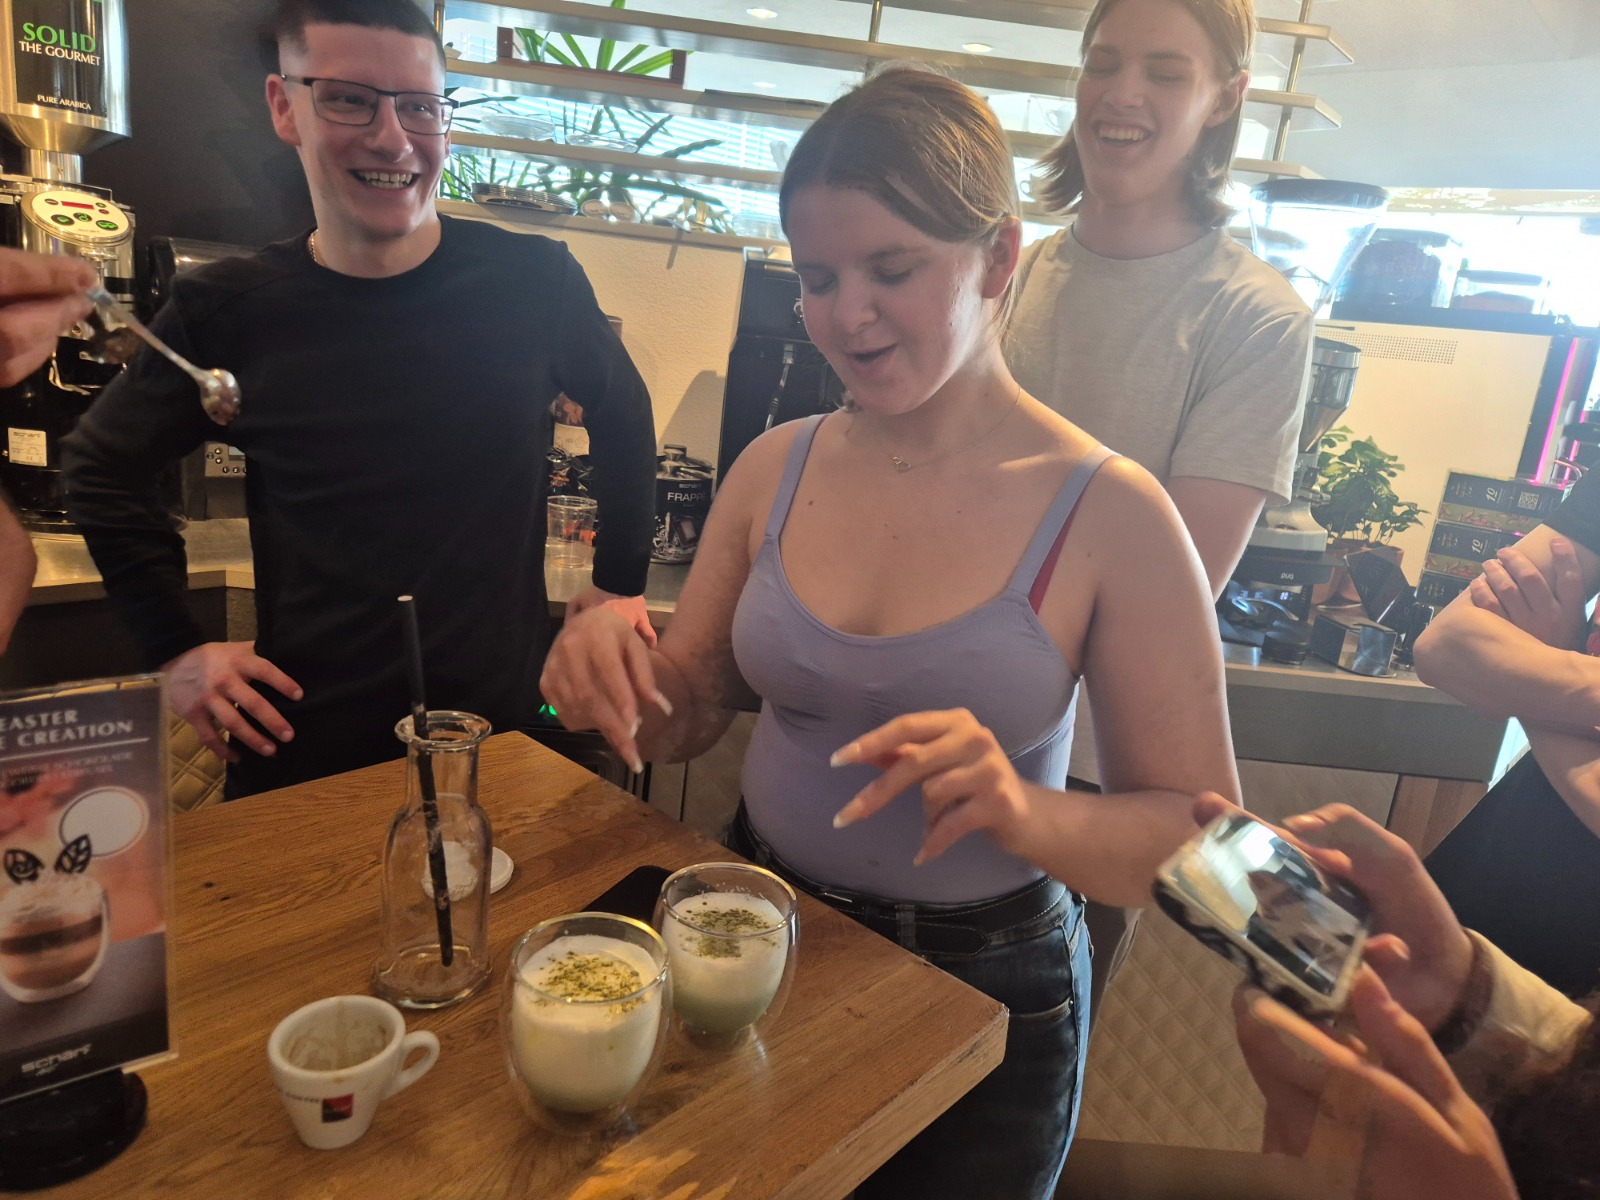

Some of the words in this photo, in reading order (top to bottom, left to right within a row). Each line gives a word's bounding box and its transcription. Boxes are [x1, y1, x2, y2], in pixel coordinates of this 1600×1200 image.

[23, 22, 96, 53] SOLID
[19, 40, 42, 54] THE
[45, 45, 101, 66] GOURMET
[37, 94, 58, 104] PURE
[59, 98, 91, 110] ARABICA
[0, 710, 78, 732] EASTER
[17, 720, 134, 747] CREATION
